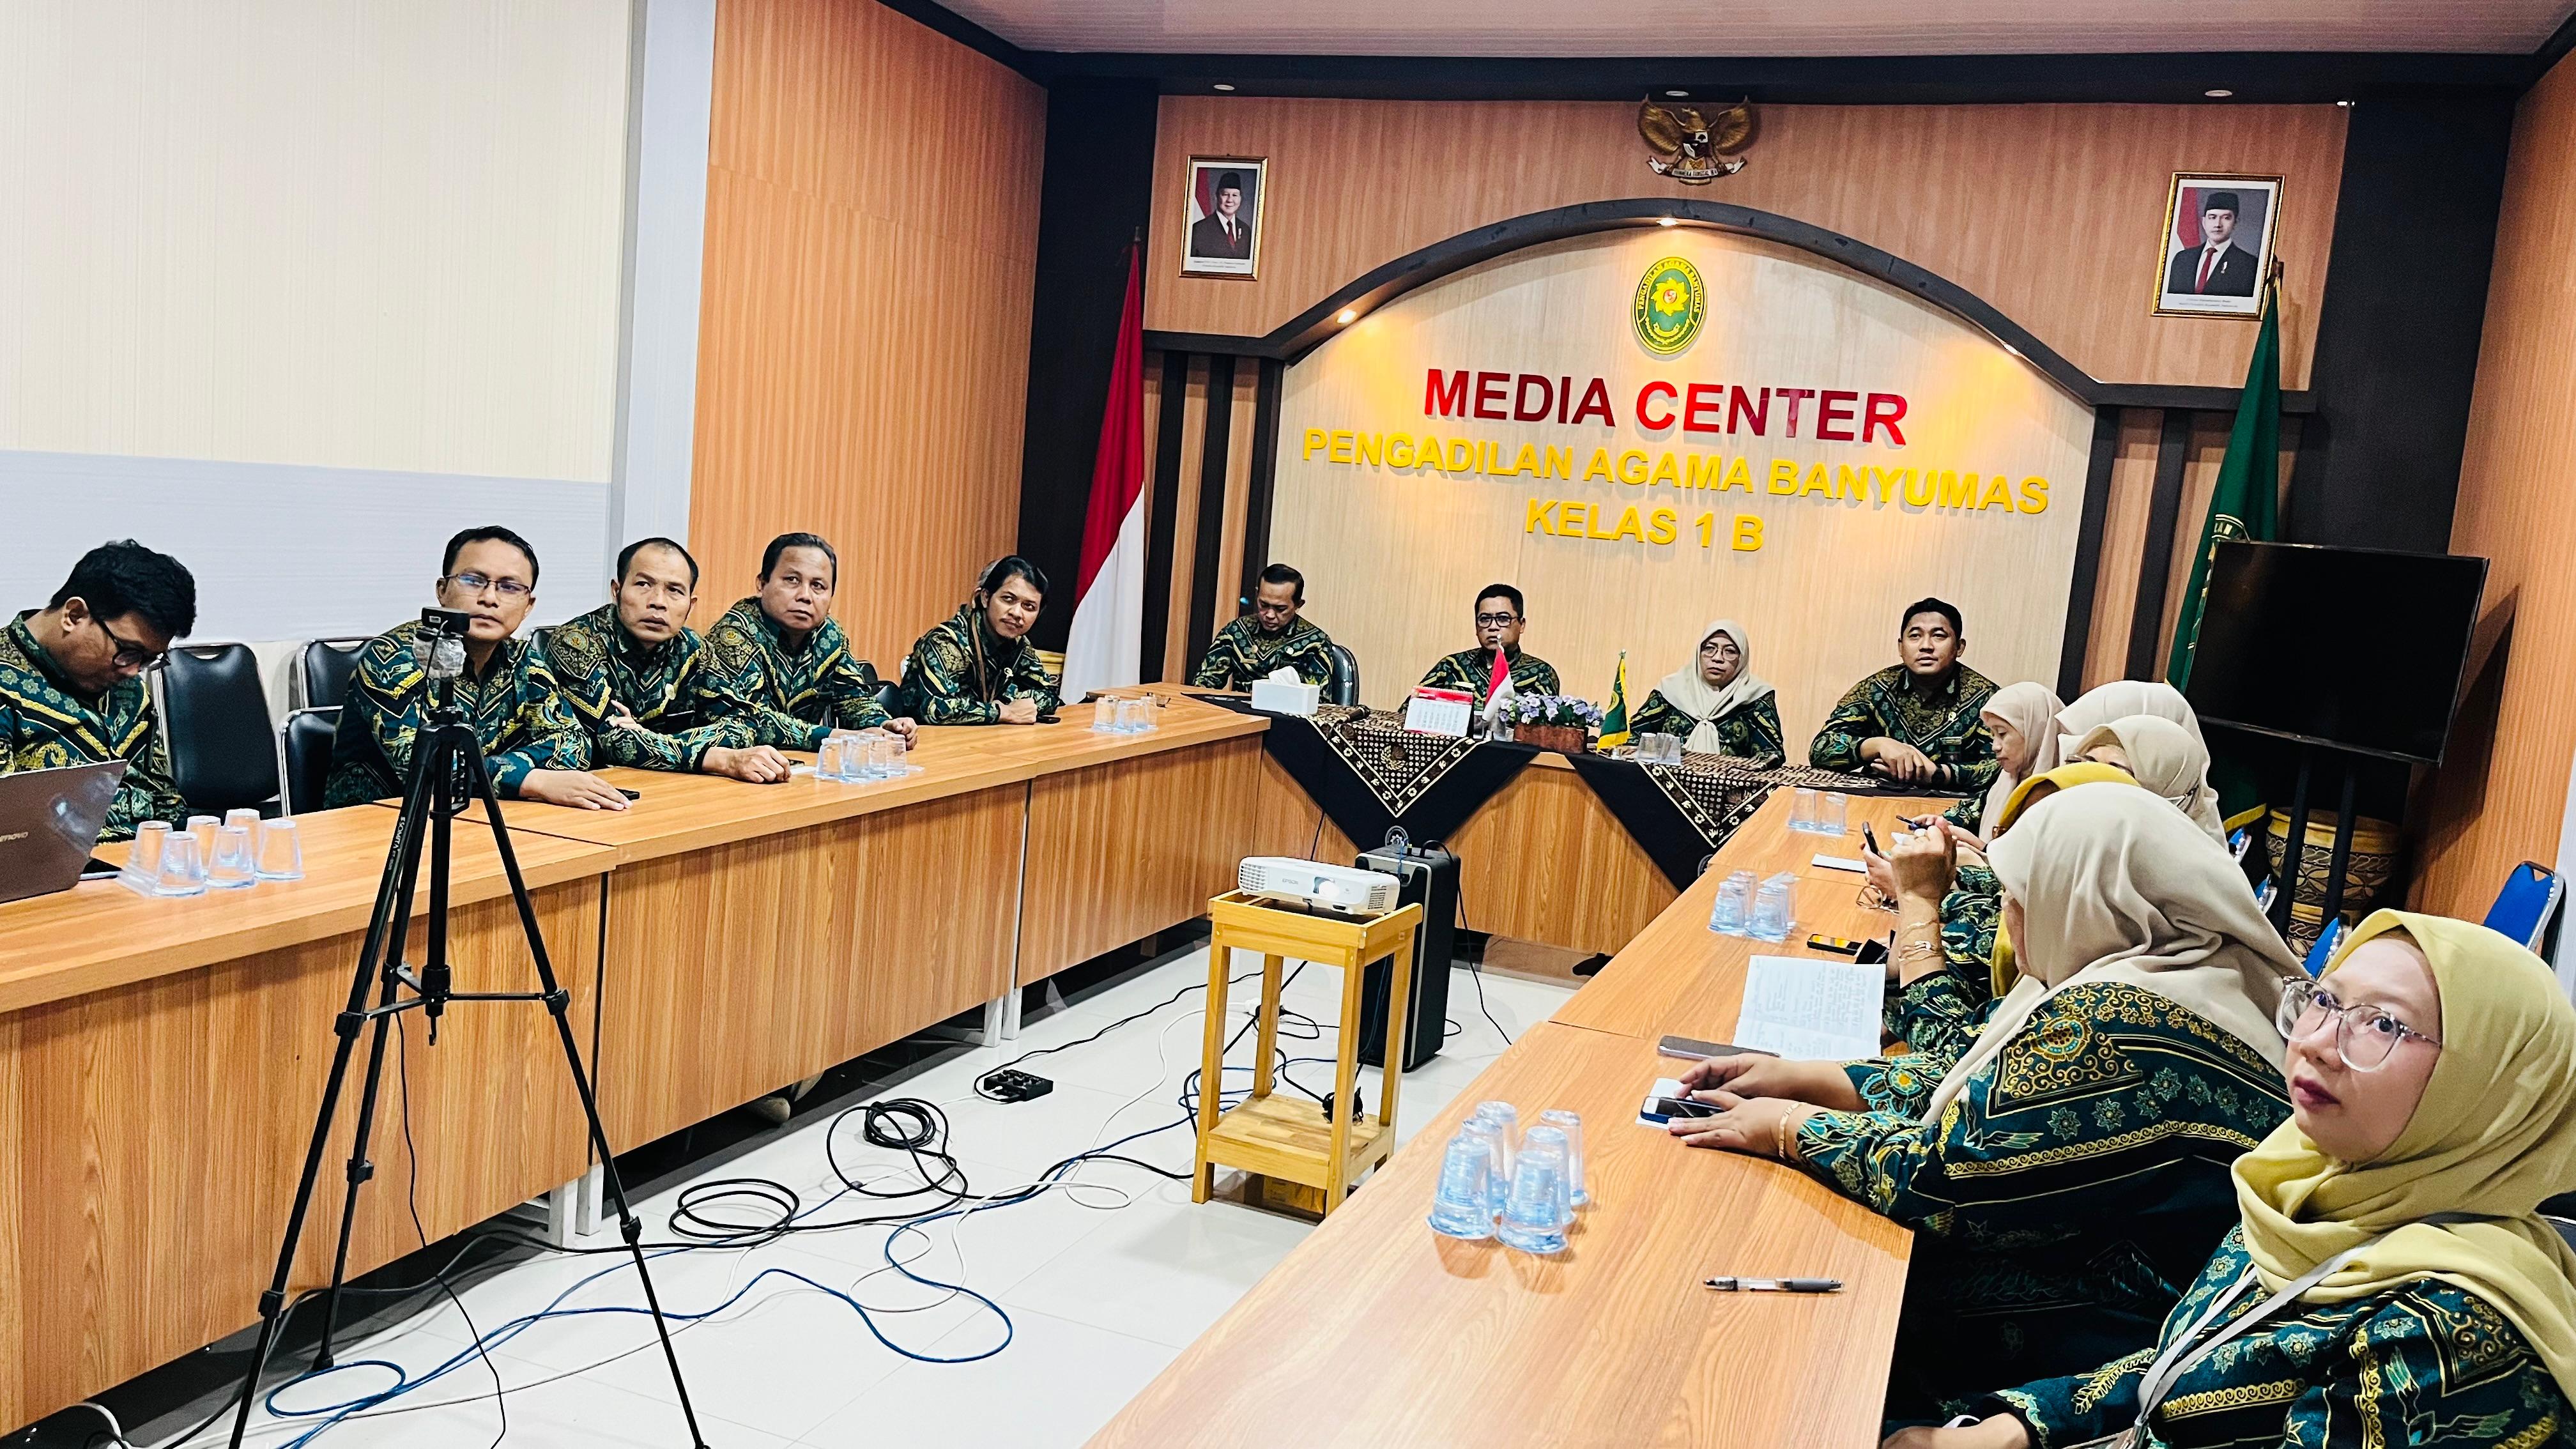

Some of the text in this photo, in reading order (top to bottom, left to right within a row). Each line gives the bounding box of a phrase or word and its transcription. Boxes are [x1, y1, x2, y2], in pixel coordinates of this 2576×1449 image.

[1424, 369, 1908, 446] MEDIA CENTER
[1303, 429, 2050, 516] PENGADILAN AGAMA BANYUMAS
[1526, 499, 1765, 553] KELAS 1 B
